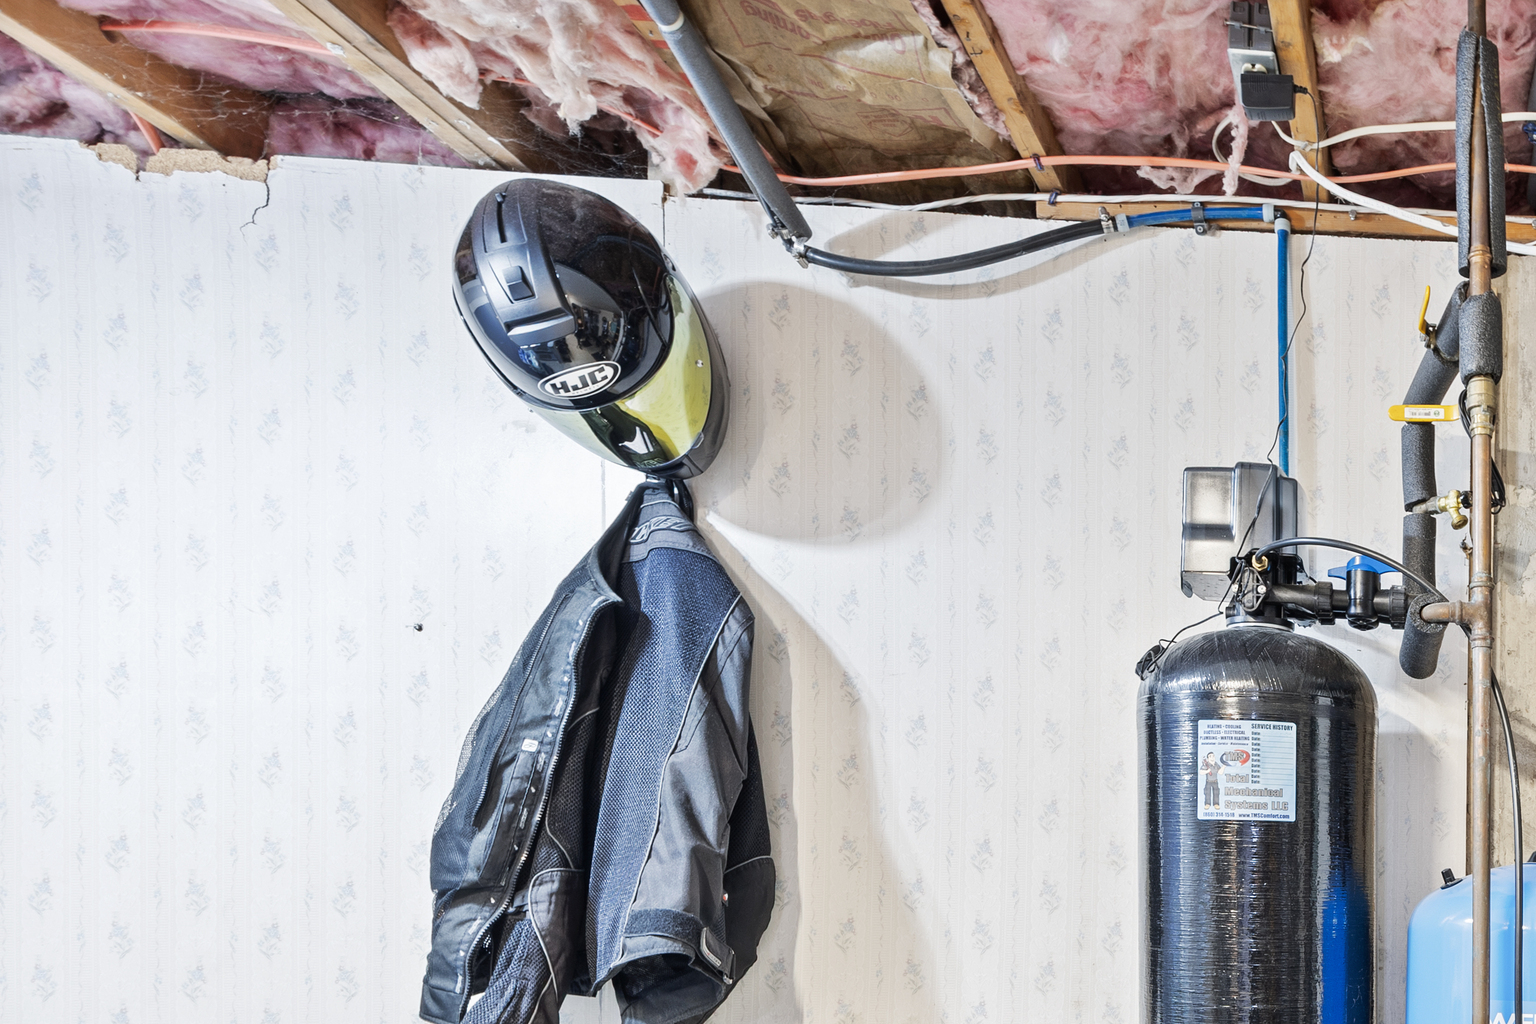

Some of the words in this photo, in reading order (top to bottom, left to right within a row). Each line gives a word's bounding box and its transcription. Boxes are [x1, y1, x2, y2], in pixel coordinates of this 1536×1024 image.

[549, 366, 609, 395] HJC
[1225, 773, 1249, 783] Total
[1224, 787, 1283, 797] Mechanical
[1224, 800, 1268, 810] Systems
[1271, 801, 1289, 811] LLC
